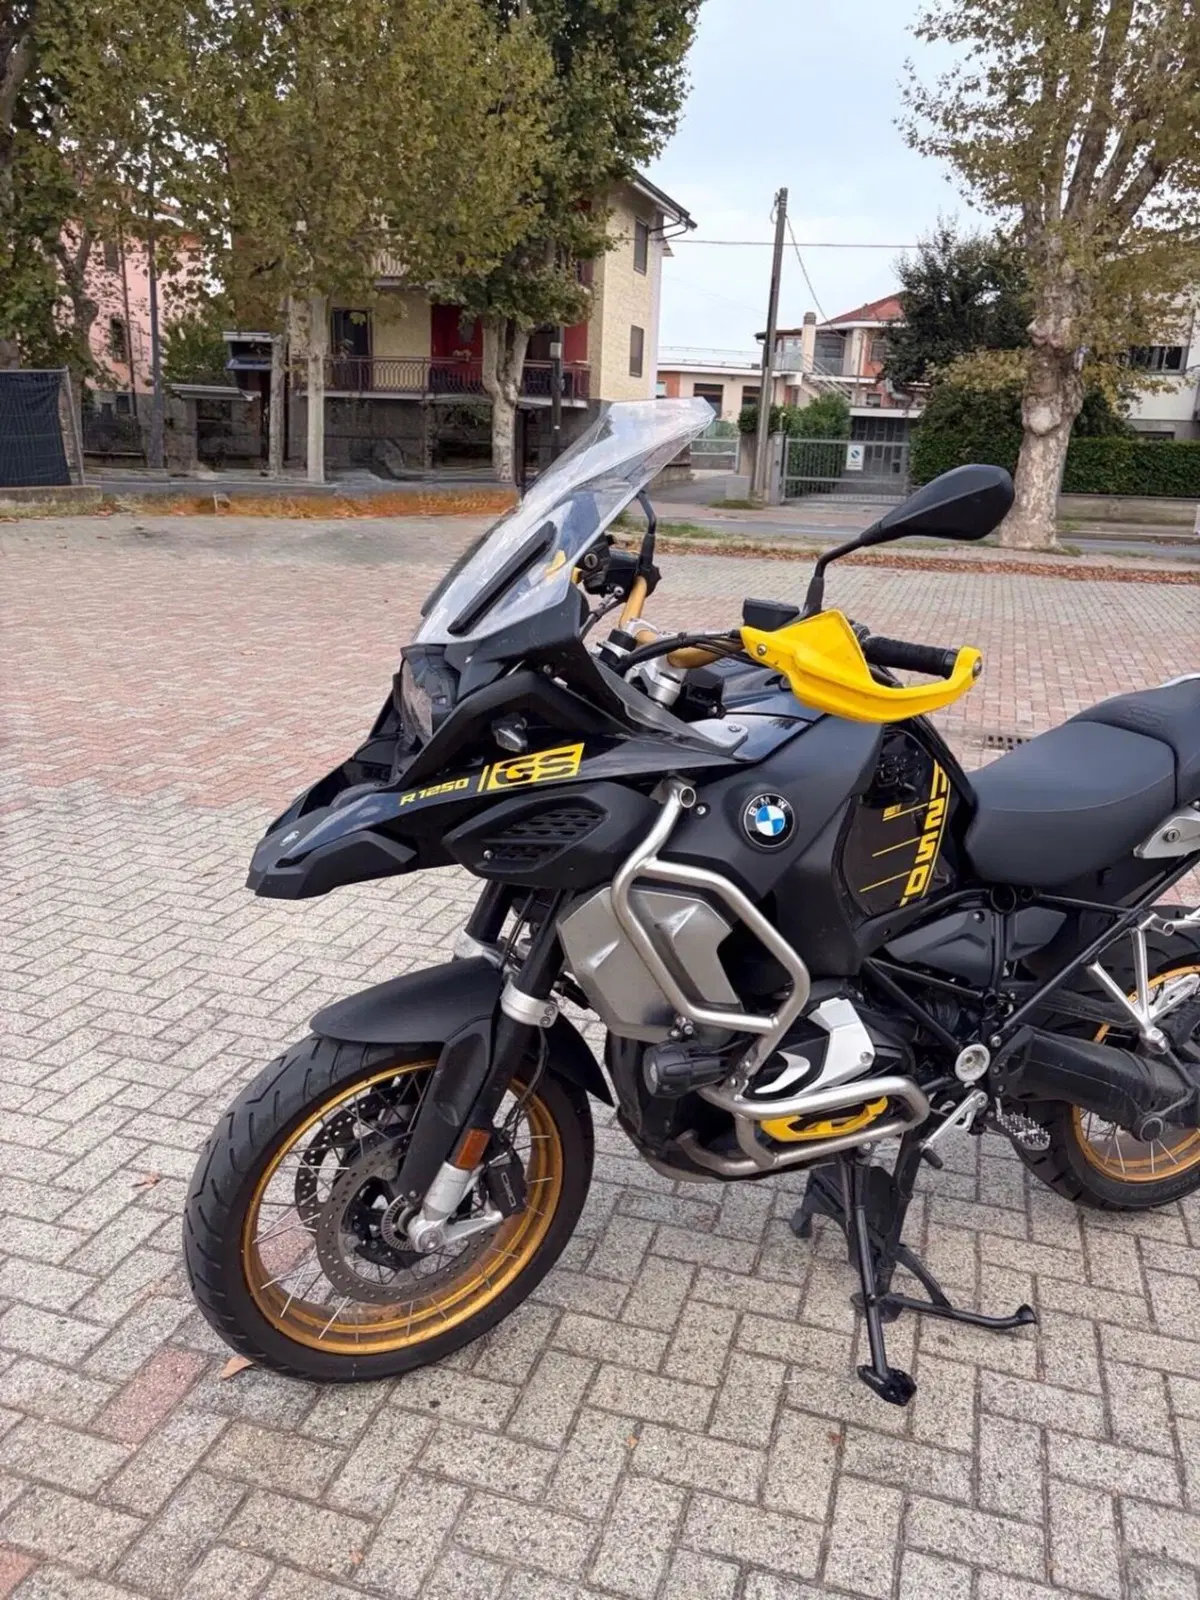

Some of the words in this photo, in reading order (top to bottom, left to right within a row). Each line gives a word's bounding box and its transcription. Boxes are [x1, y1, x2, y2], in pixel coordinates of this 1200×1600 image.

[399, 792, 416, 806] R
[419, 777, 470, 800] 1250
[495, 750, 576, 785] GS
[748, 796, 788, 816] BMW
